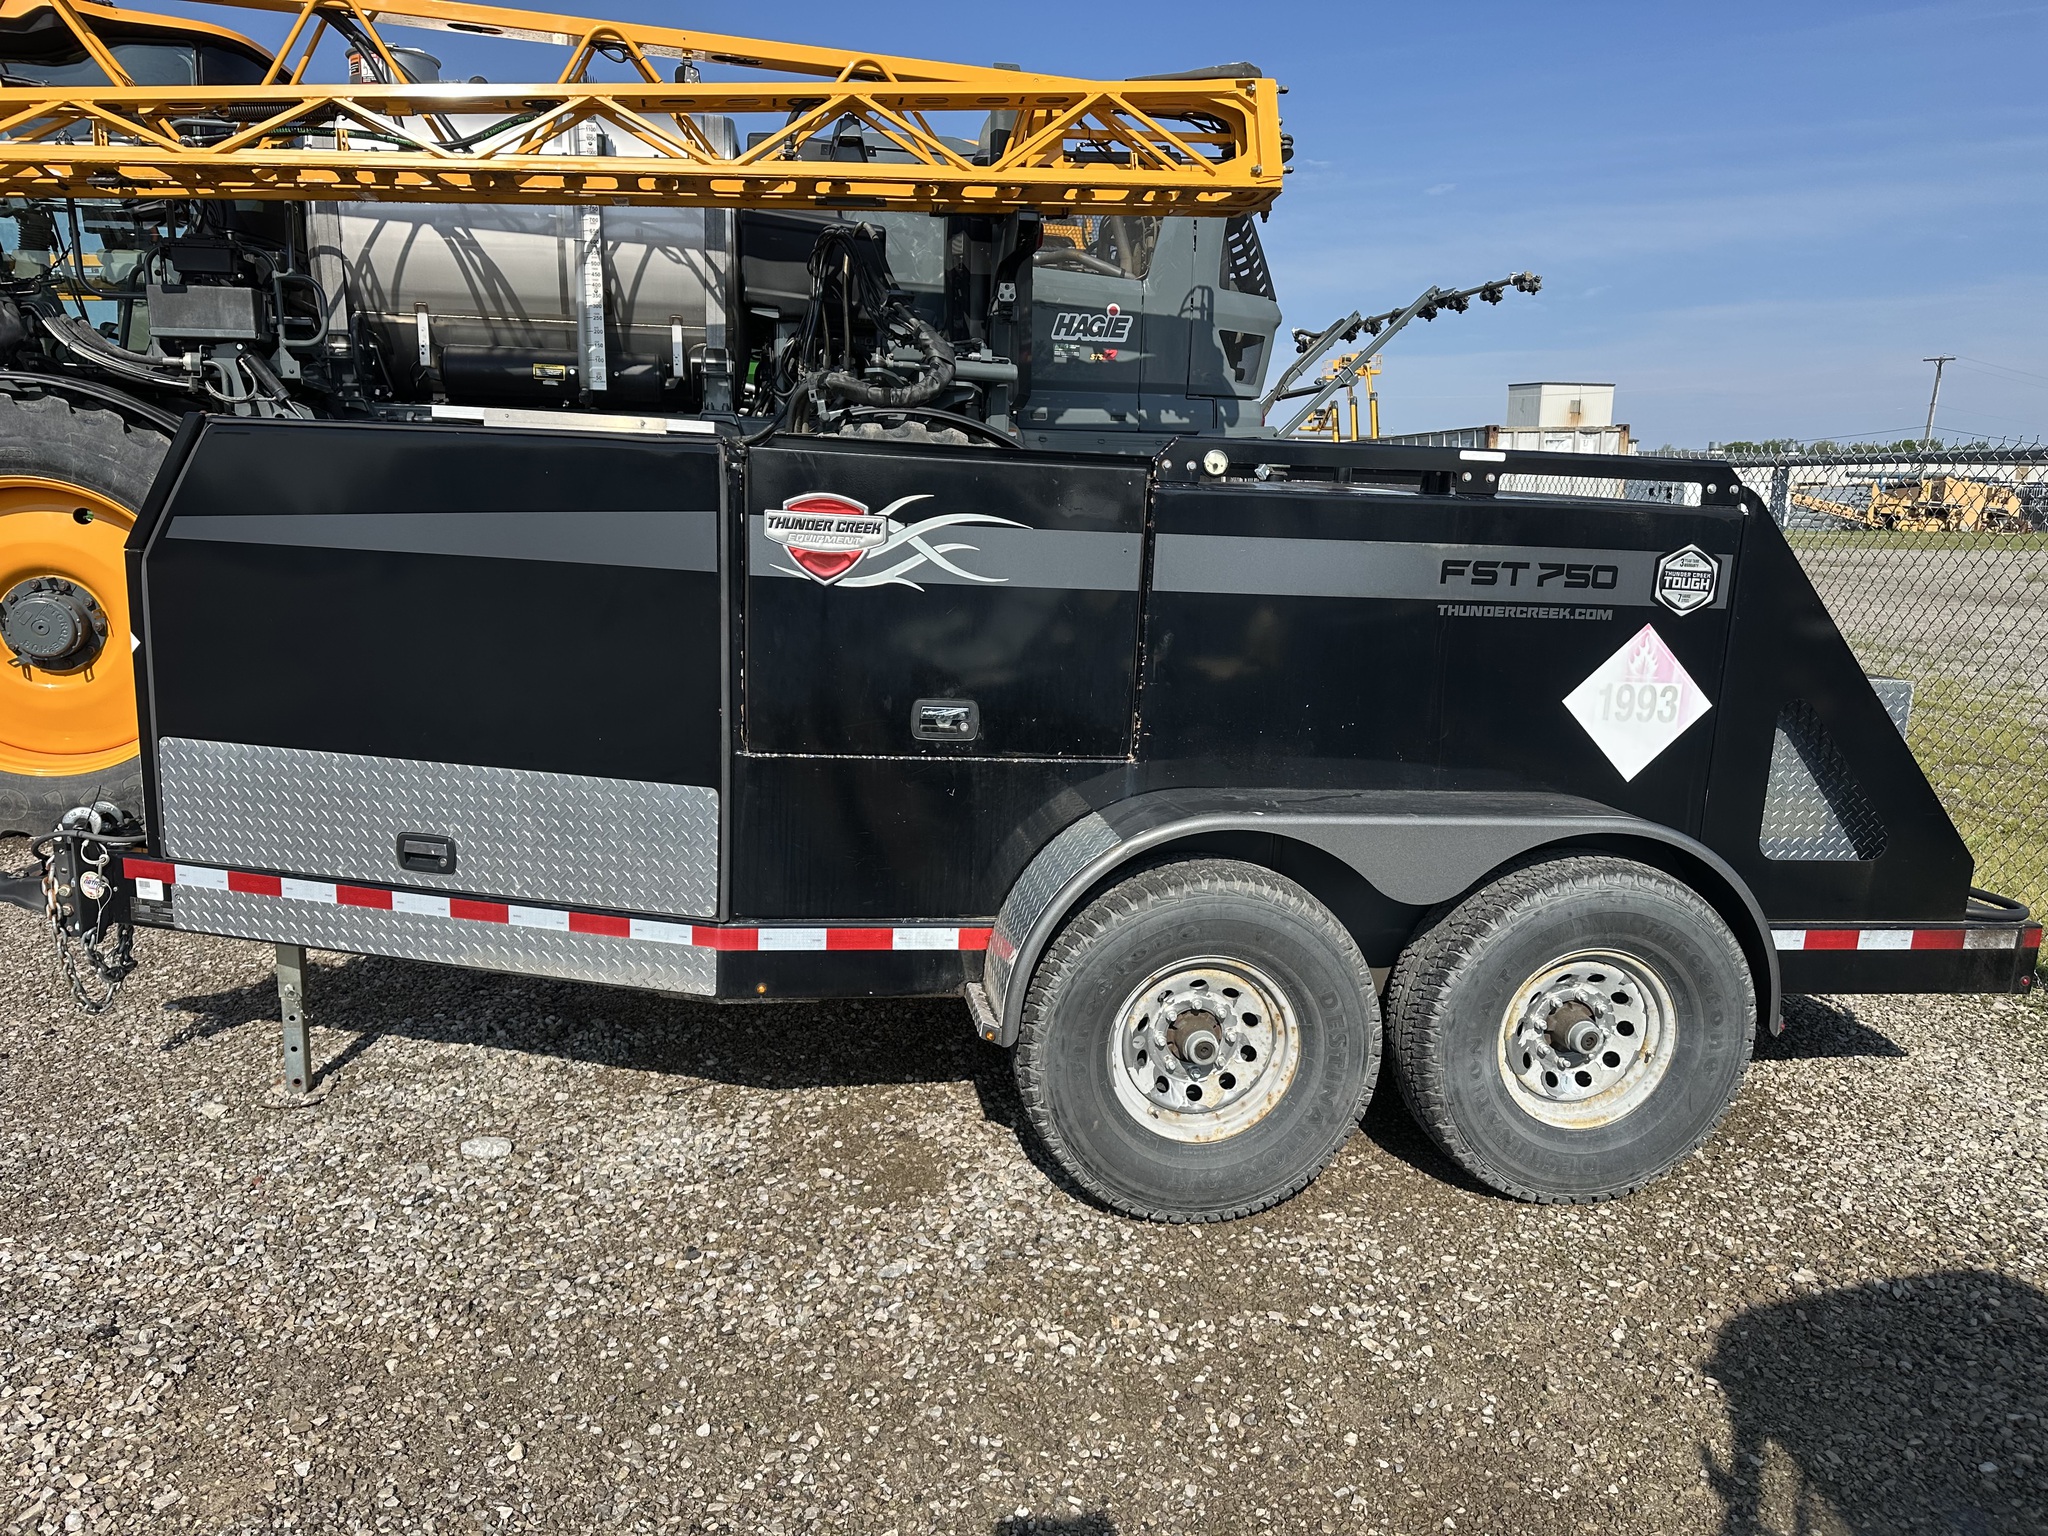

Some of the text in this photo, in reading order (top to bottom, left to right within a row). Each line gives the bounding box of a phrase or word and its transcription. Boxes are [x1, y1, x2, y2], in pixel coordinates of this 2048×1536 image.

[1051, 304, 1133, 342] HAGIE
[767, 515, 883, 535] THUNDER CREEK
[786, 532, 864, 545] EQUIPMENT
[1439, 559, 1619, 590] FST 750
[1663, 576, 1711, 591] TOUGH
[1665, 570, 1692, 578] THUNDER
[1437, 604, 1614, 621] THUNDERCREEK.COM
[1599, 682, 1680, 724] 1993
[1244, 990, 1348, 1183] DESTINATION
